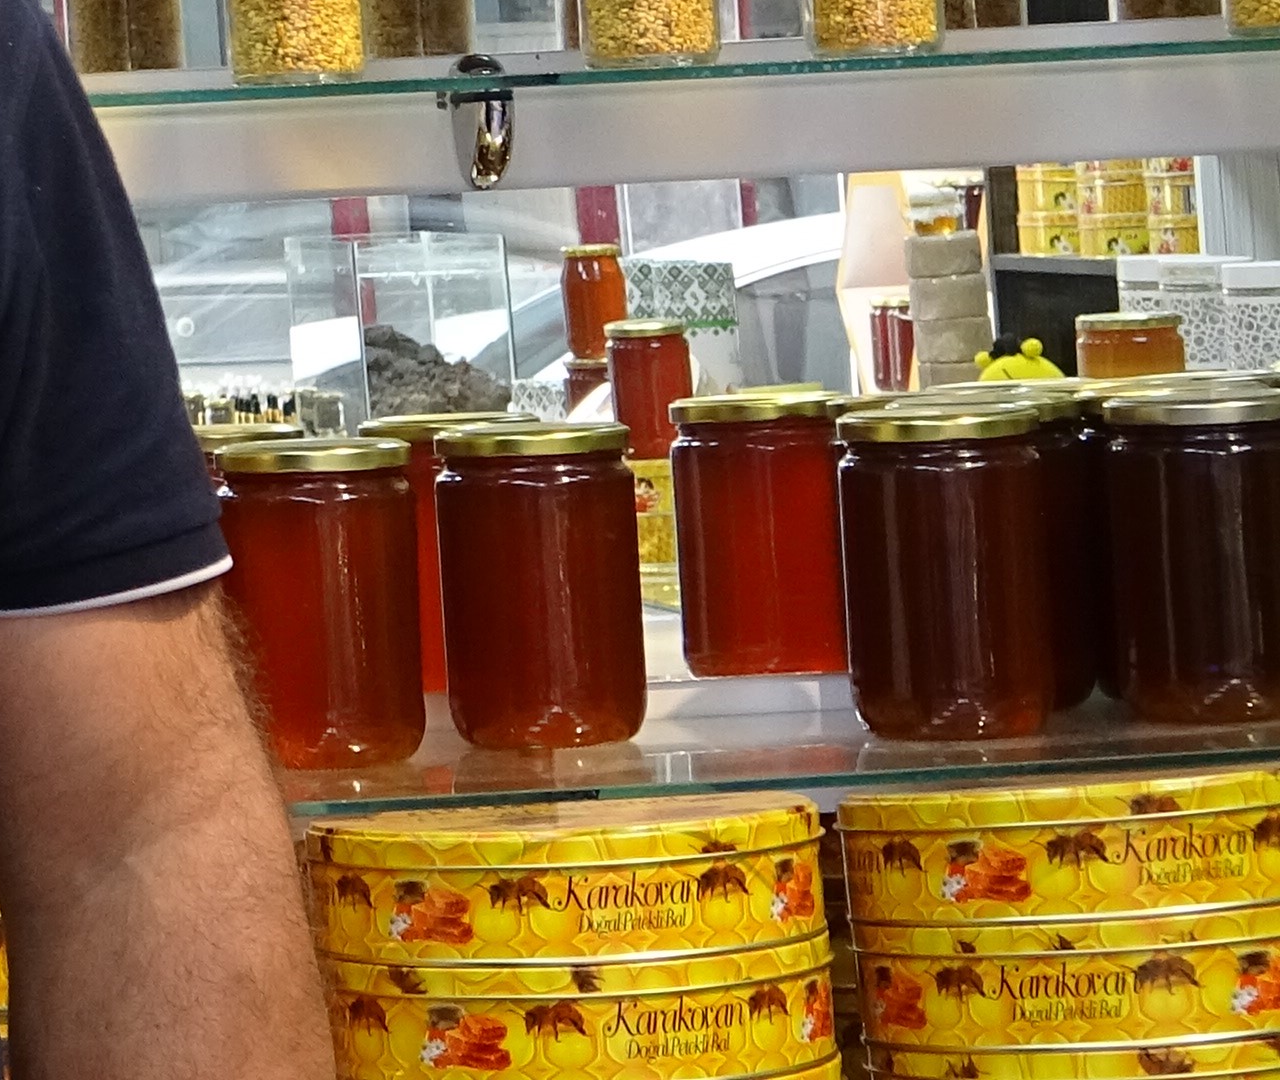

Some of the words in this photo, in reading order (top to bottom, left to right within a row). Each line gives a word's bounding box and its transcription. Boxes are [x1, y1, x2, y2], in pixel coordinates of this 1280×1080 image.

[1111, 823, 1257, 865] Karakovan
[550, 871, 701, 912] Karakovan
[666, 907, 687, 928] Bal
[988, 962, 1141, 1001] Karakovan
[602, 995, 746, 1038] Karakovan
[1099, 998, 1123, 1019] Bal
[627, 1037, 669, 1065] Doğal
[671, 1034, 710, 1057] Petekli
[711, 1032, 731, 1053] Bal
